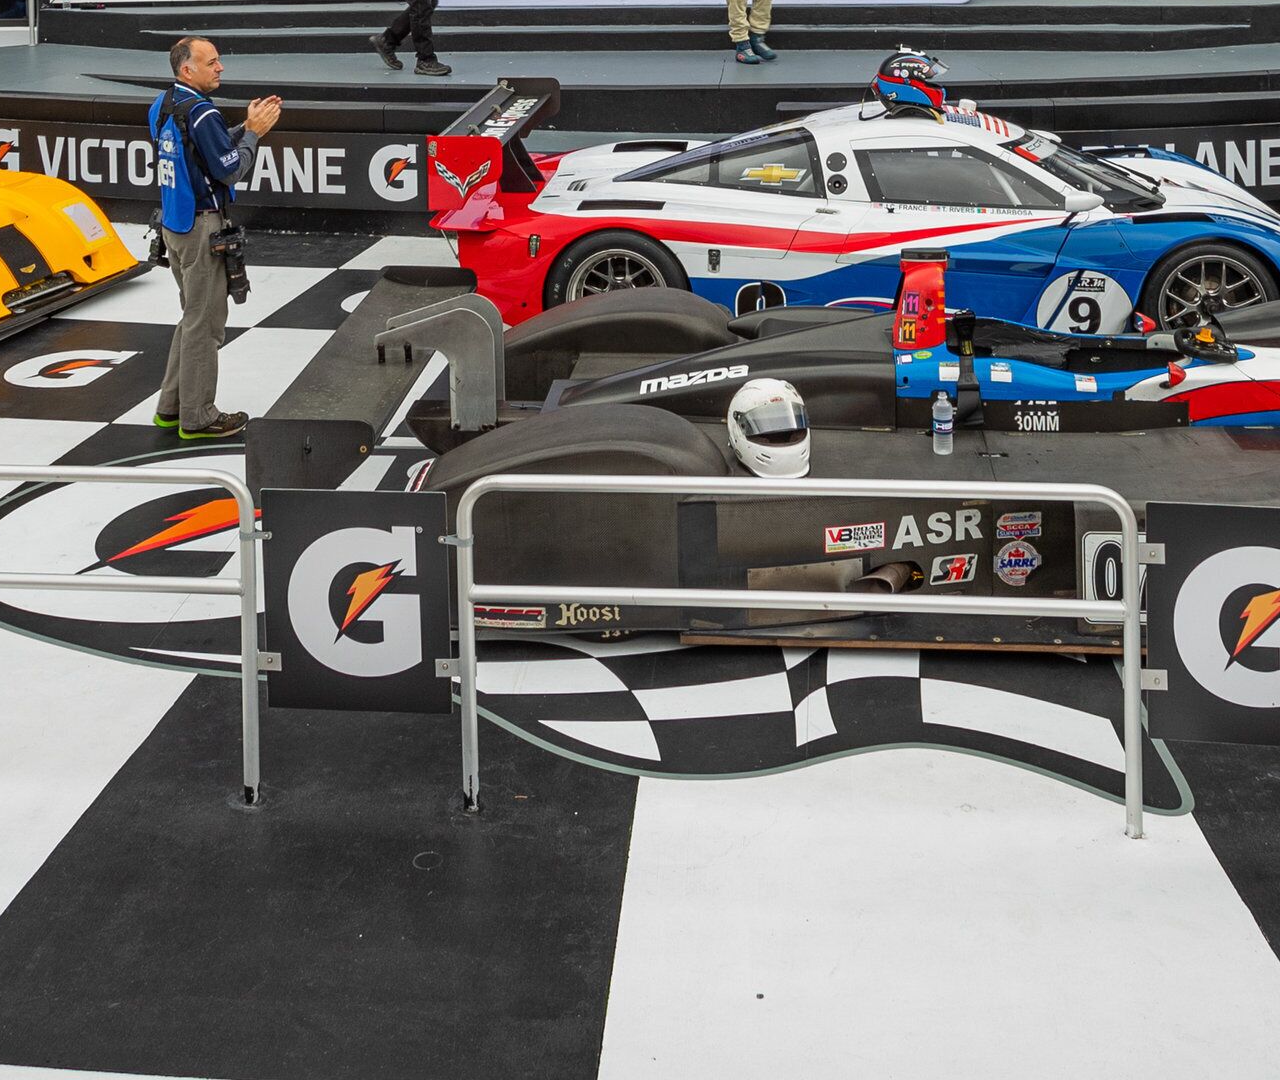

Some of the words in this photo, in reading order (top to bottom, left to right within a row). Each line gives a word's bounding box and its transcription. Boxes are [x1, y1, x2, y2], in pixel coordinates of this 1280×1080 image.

[37, 135, 159, 186] VICTO
[235, 146, 346, 195] ANE
[368, 144, 418, 202] G
[898, 204, 928, 212] FRANCE
[906, 294, 920, 312] 11
[1068, 296, 1102, 334] 9
[904, 320, 916, 341] 11
[4, 350, 141, 388] G
[892, 508, 984, 550] ASR
[999, 557, 1037, 569] SARRC
[287, 526, 422, 678] G
[555, 602, 621, 626] Hoosi
